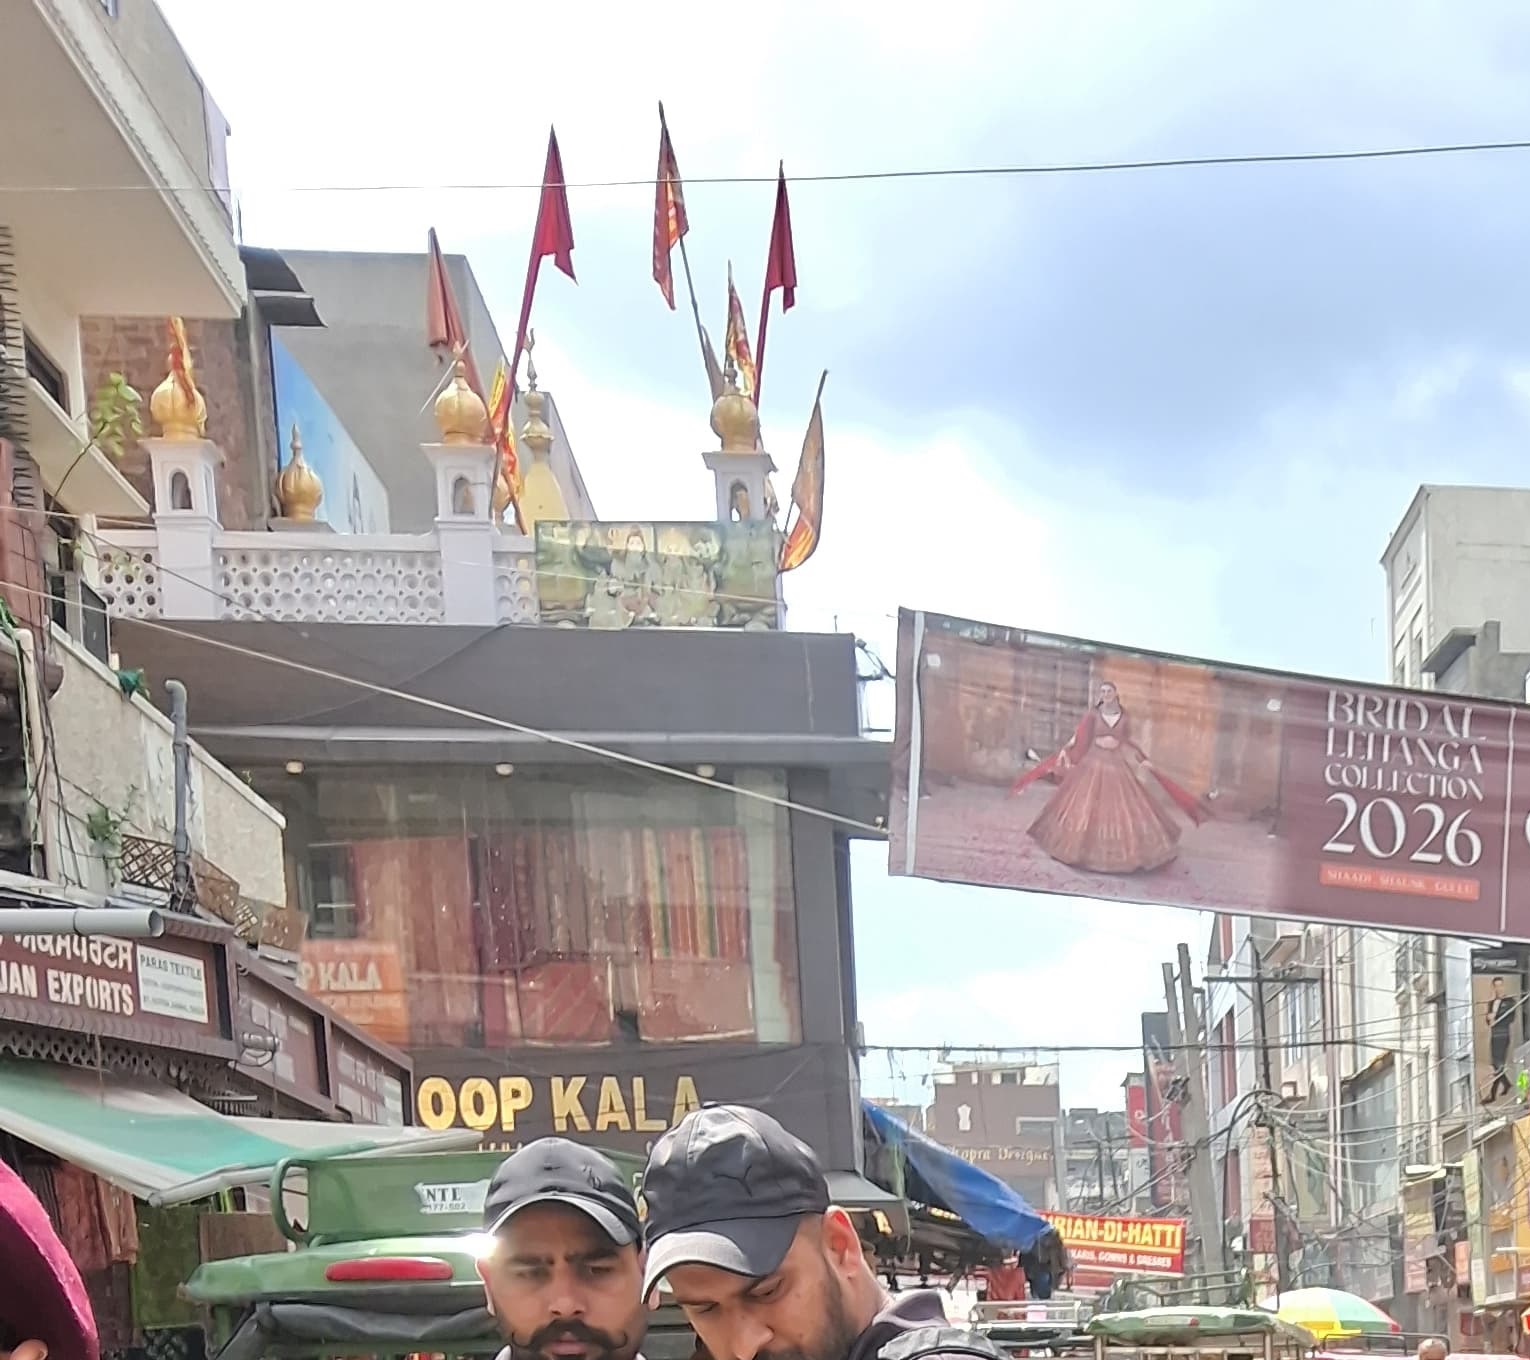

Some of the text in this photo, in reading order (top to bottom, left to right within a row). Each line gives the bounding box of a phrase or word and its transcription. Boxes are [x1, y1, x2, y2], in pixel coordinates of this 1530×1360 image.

[1326, 690, 1487, 741] BRIDAL
[1325, 727, 1484, 775] LEHANGA
[1324, 763, 1484, 802] COLLECTION
[1322, 792, 1483, 867] 2026
[47, 968, 135, 1017] EXPORTS
[318, 961, 382, 990] KALA
[550, 1075, 702, 1132] KALA
